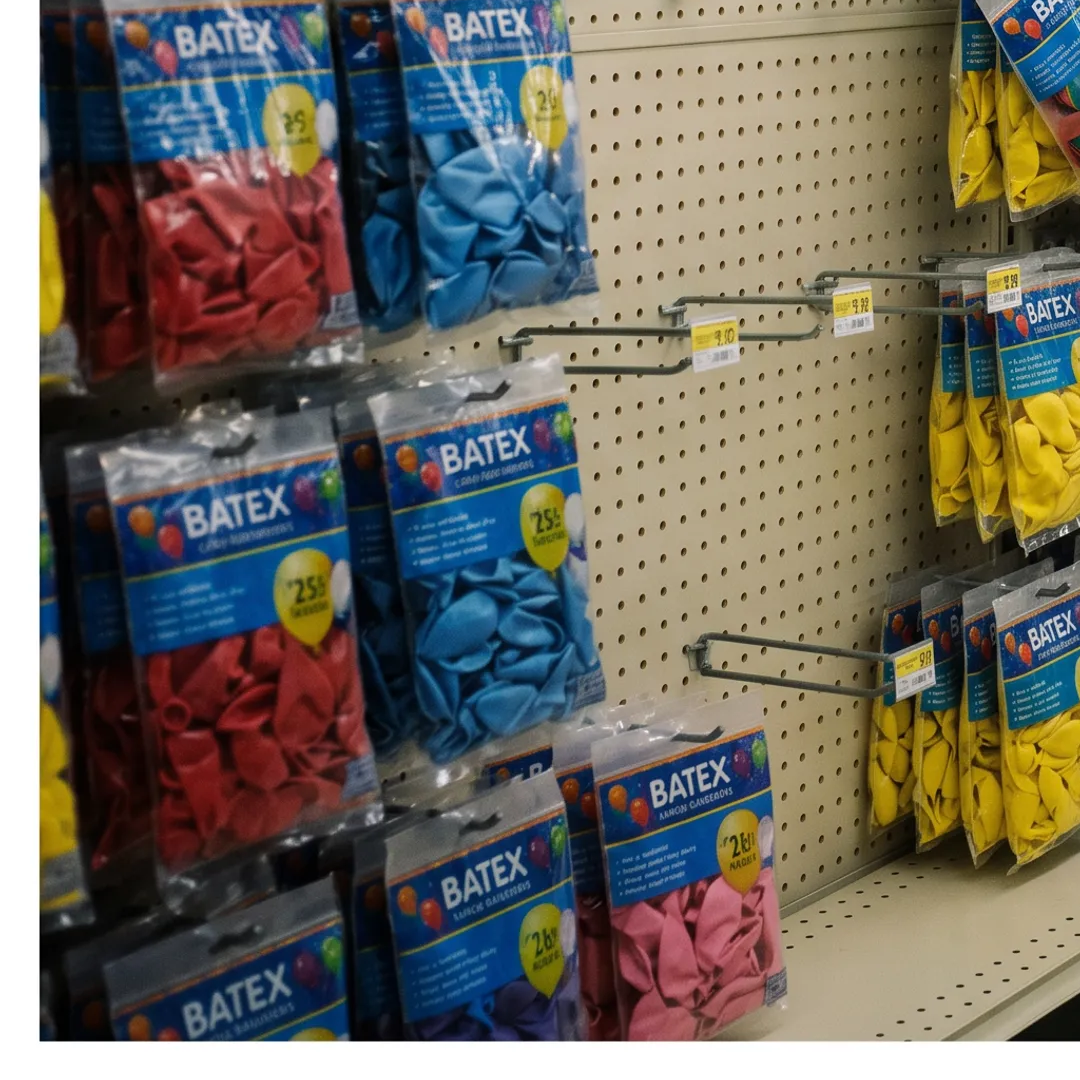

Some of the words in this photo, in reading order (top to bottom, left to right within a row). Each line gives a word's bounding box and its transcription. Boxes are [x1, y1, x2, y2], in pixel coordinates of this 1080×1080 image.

[174, 19, 279, 59] BATEX
[444, 7, 533, 43] BATEX
[1025, 294, 1076, 324] BATEX
[440, 425, 531, 475] BATEX
[182, 484, 291, 540] BATEX
[1028, 609, 1077, 651] BATEX
[650, 755, 731, 809] BATEX
[441, 845, 528, 910] BATEX
[182, 963, 292, 1040] BATEX
